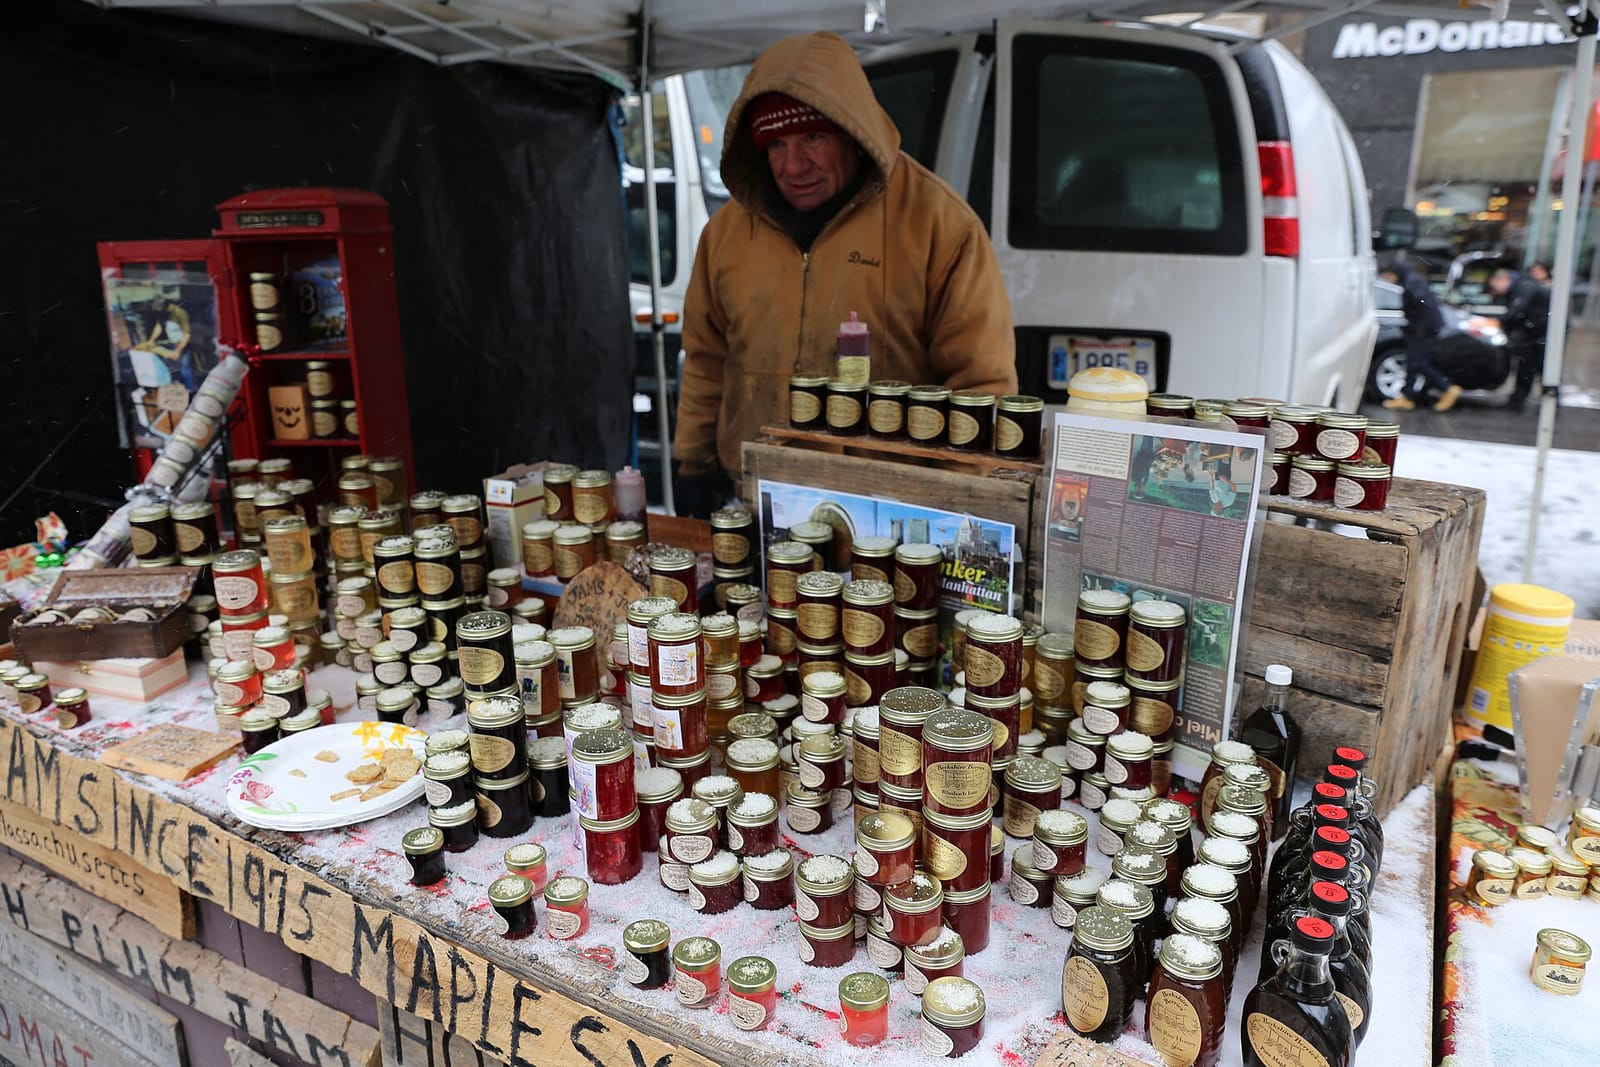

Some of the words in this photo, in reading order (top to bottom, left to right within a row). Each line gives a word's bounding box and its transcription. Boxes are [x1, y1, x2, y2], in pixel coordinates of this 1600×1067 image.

[940, 558, 987, 583] nker
[1187, 719, 1221, 743] Miel
[224, 839, 333, 942] 1975
[351, 902, 543, 1067] MAPLE
[61, 909, 196, 1008] PLUM
[225, 991, 351, 1067] JAM
[1261, 1016, 1295, 1040] Berkshire
